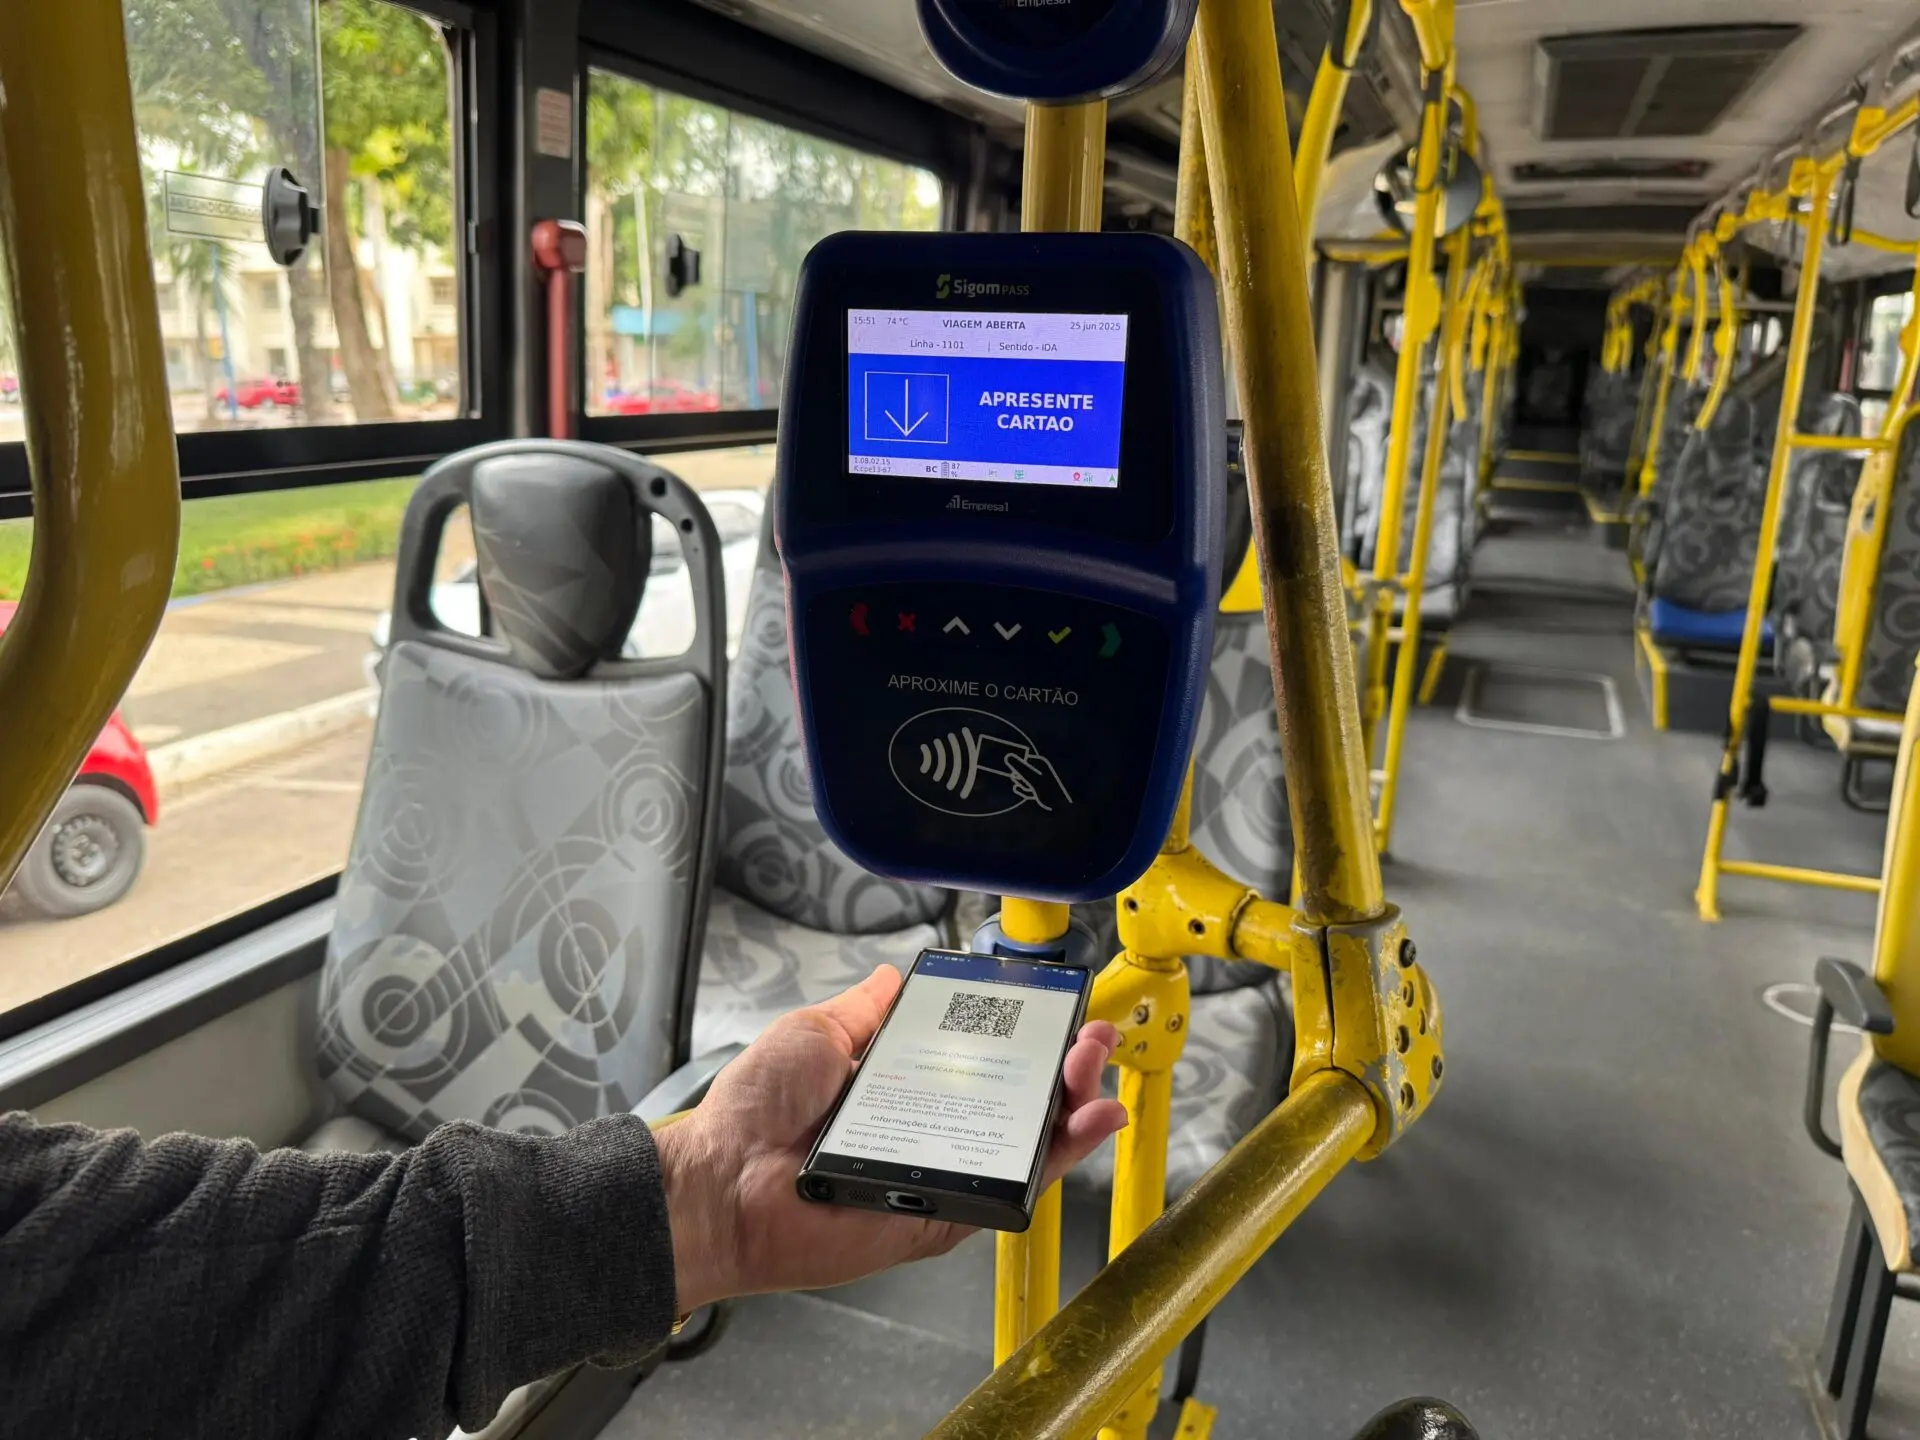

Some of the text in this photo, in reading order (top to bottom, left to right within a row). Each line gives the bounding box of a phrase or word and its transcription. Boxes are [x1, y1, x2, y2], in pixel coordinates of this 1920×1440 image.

[853, 316, 876, 325] 15:51
[887, 317, 898, 325] 74
[942, 319, 1026, 330] VIAGEM ABERTA
[1070, 322, 1121, 332] 25 jun 2025
[910, 339, 934, 349] Linha
[942, 341, 964, 349] 1101
[999, 342, 1033, 352] Sentido
[979, 391, 1094, 411] APRESENTE
[996, 413, 1074, 432] CARTAO
[962, 500, 1009, 512] Empresa1
[888, 674, 1079, 706] APROXIME O CARTÃO
[914, 1063, 955, 1075] VERIFICAR
[869, 1114, 1005, 1140] Informações da cobrança PIX
[839, 1140, 858, 1149] Tipo
[958, 1157, 984, 1167] Ticket
